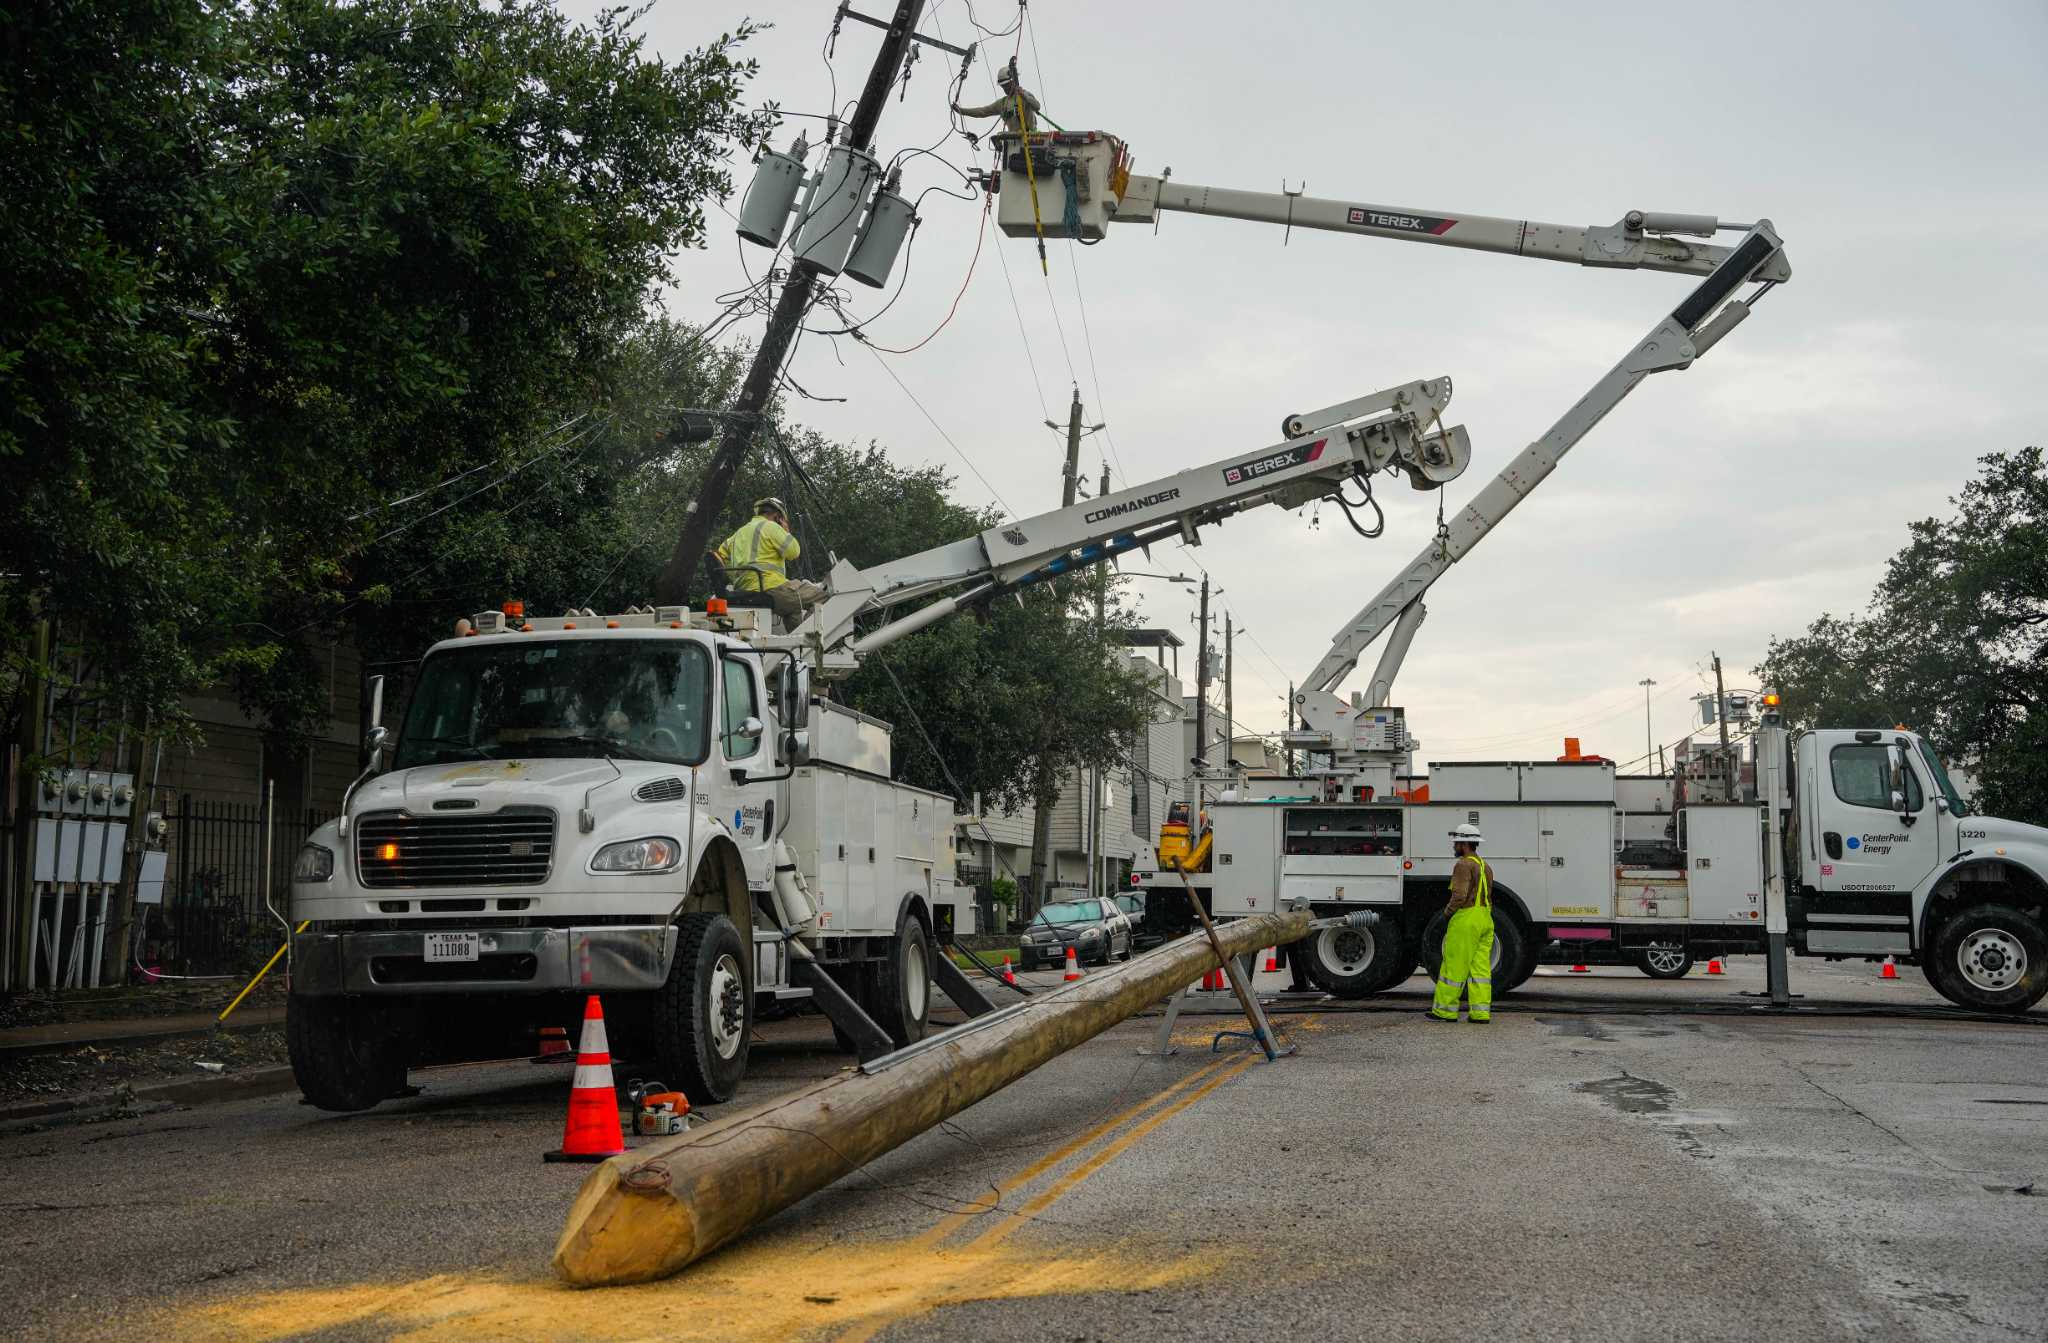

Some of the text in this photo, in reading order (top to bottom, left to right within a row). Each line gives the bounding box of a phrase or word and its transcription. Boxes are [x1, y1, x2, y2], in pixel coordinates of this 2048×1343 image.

[1369, 213, 1420, 229] TEREX
[1244, 452, 1297, 476] TEREX
[1084, 488, 1180, 524] COMMANDER
[1862, 833, 1909, 842] CenterPoint
[1960, 830, 1986, 839] 3220
[1863, 844, 1892, 855] Energy
